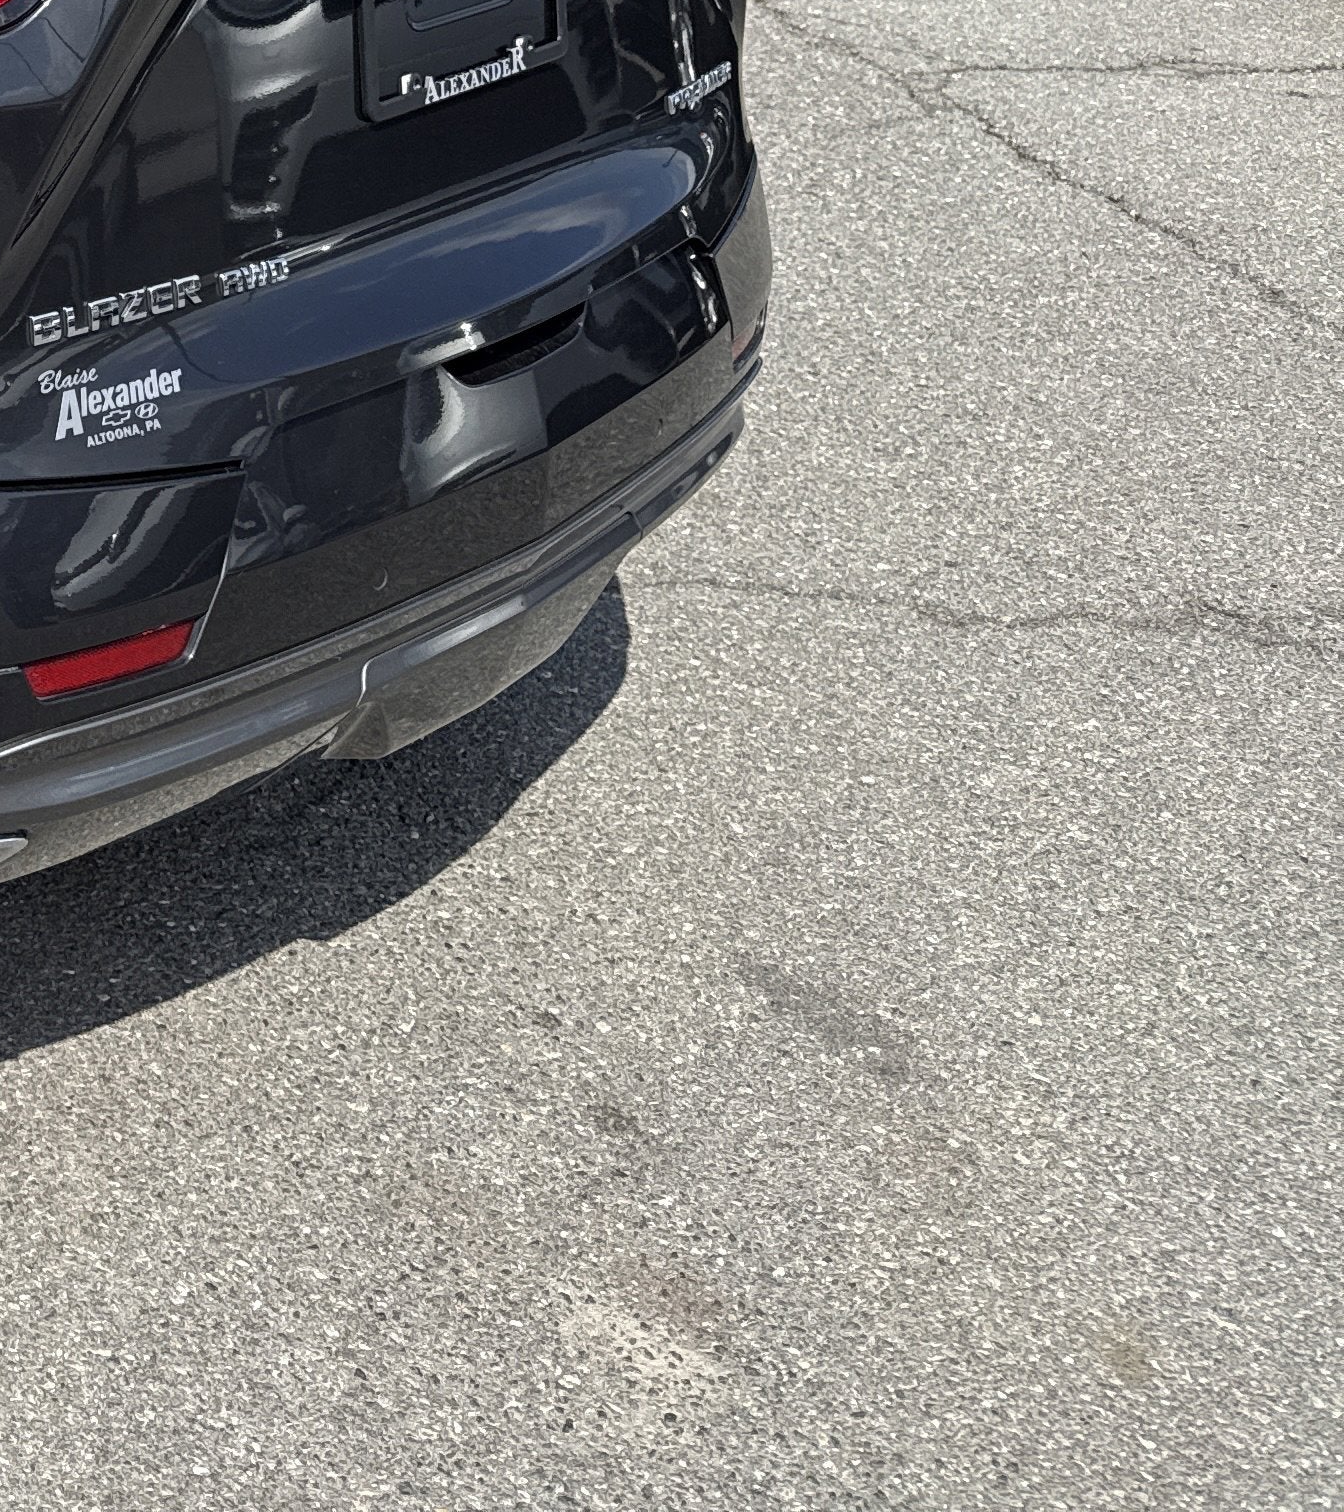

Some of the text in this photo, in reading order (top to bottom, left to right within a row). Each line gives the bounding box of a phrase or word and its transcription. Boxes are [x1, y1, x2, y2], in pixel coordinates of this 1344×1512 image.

[424, 45, 527, 105] ALEXANDER
[28, 257, 291, 347] BLAZER AWD
[38, 367, 99, 394] Blaise
[55, 368, 182, 441] Alexander
[86, 417, 162, 448] ALTOONA, PA
